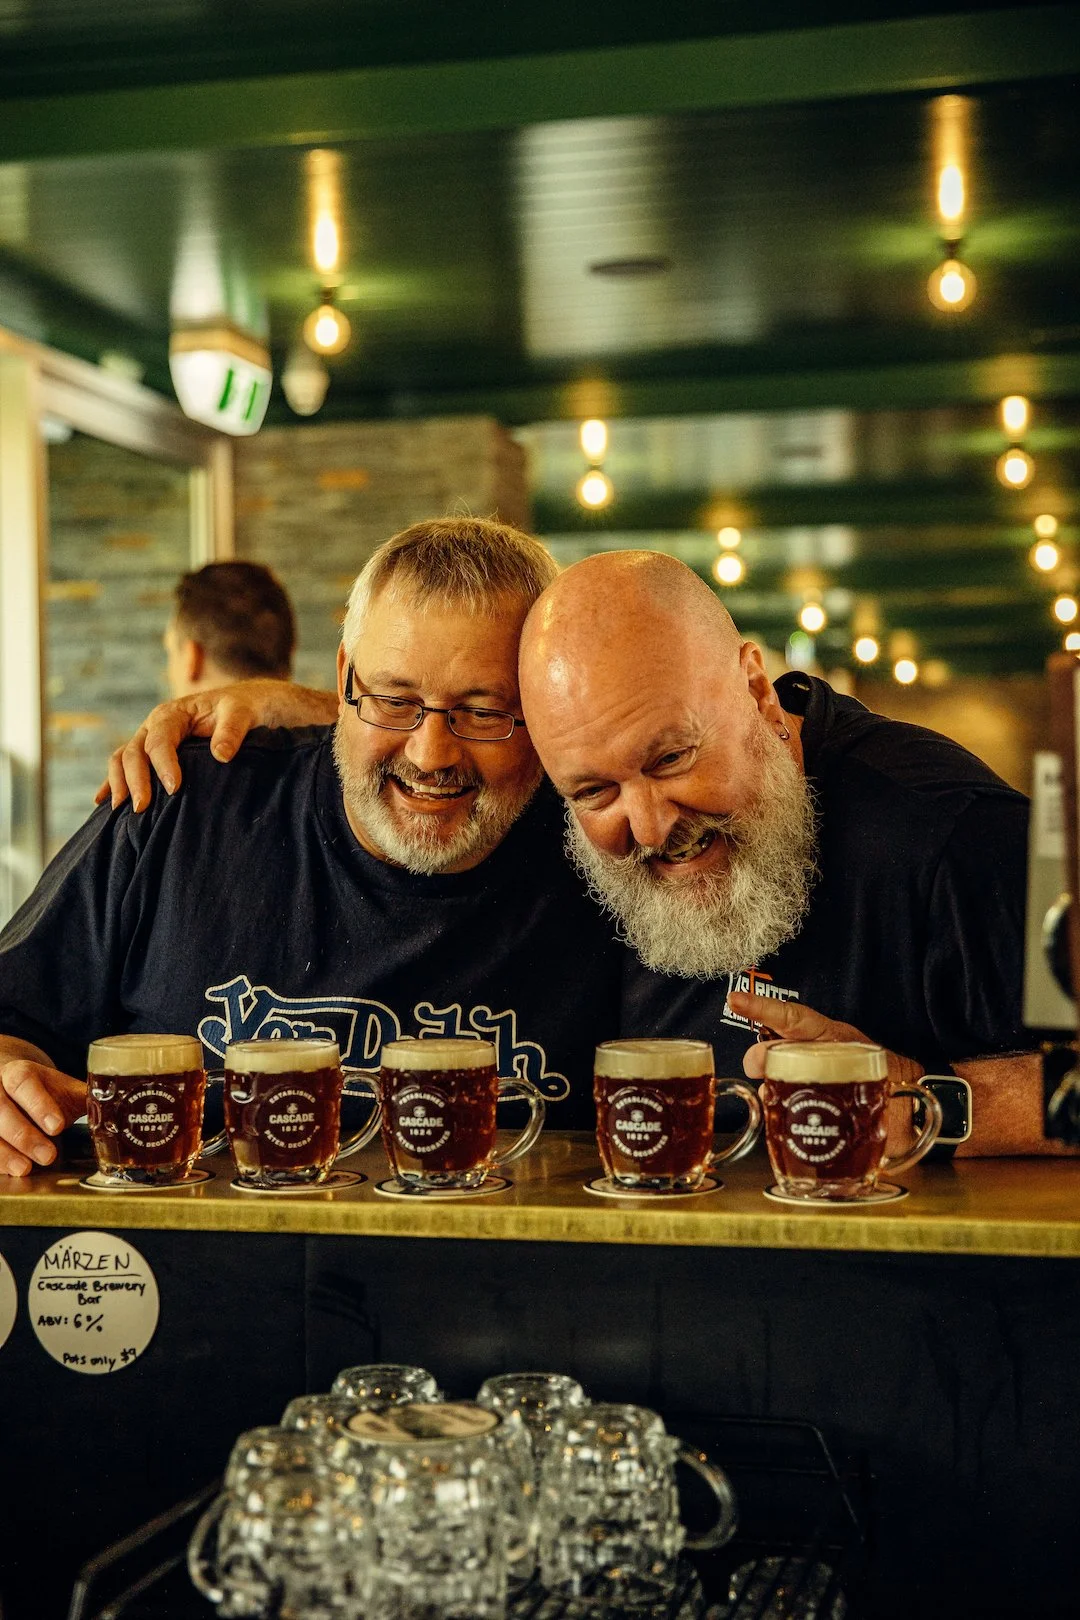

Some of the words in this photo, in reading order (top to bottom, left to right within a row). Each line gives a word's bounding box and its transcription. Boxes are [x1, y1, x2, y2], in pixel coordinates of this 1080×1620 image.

[128, 1090, 176, 1104] ESTABLISHED
[128, 1113, 174, 1123] CASCADE
[269, 1113, 315, 1124] CASCADE
[399, 1116, 444, 1127] CASCADE
[616, 1119, 662, 1132] CASCADE
[791, 1123, 840, 1137] CASCADE
[44, 1245, 130, 1270] MÄRZEN
[38, 1281, 87, 1291] Cascade
[93, 1281, 145, 1296] Brewery
[78, 1294, 101, 1305] Bar
[38, 1315, 68, 1326] ABV:
[73, 1313, 104, 1332] 6%
[63, 1353, 86, 1364] Pots
[90, 1355, 116, 1371] only
[120, 1348, 137, 1363] $9
